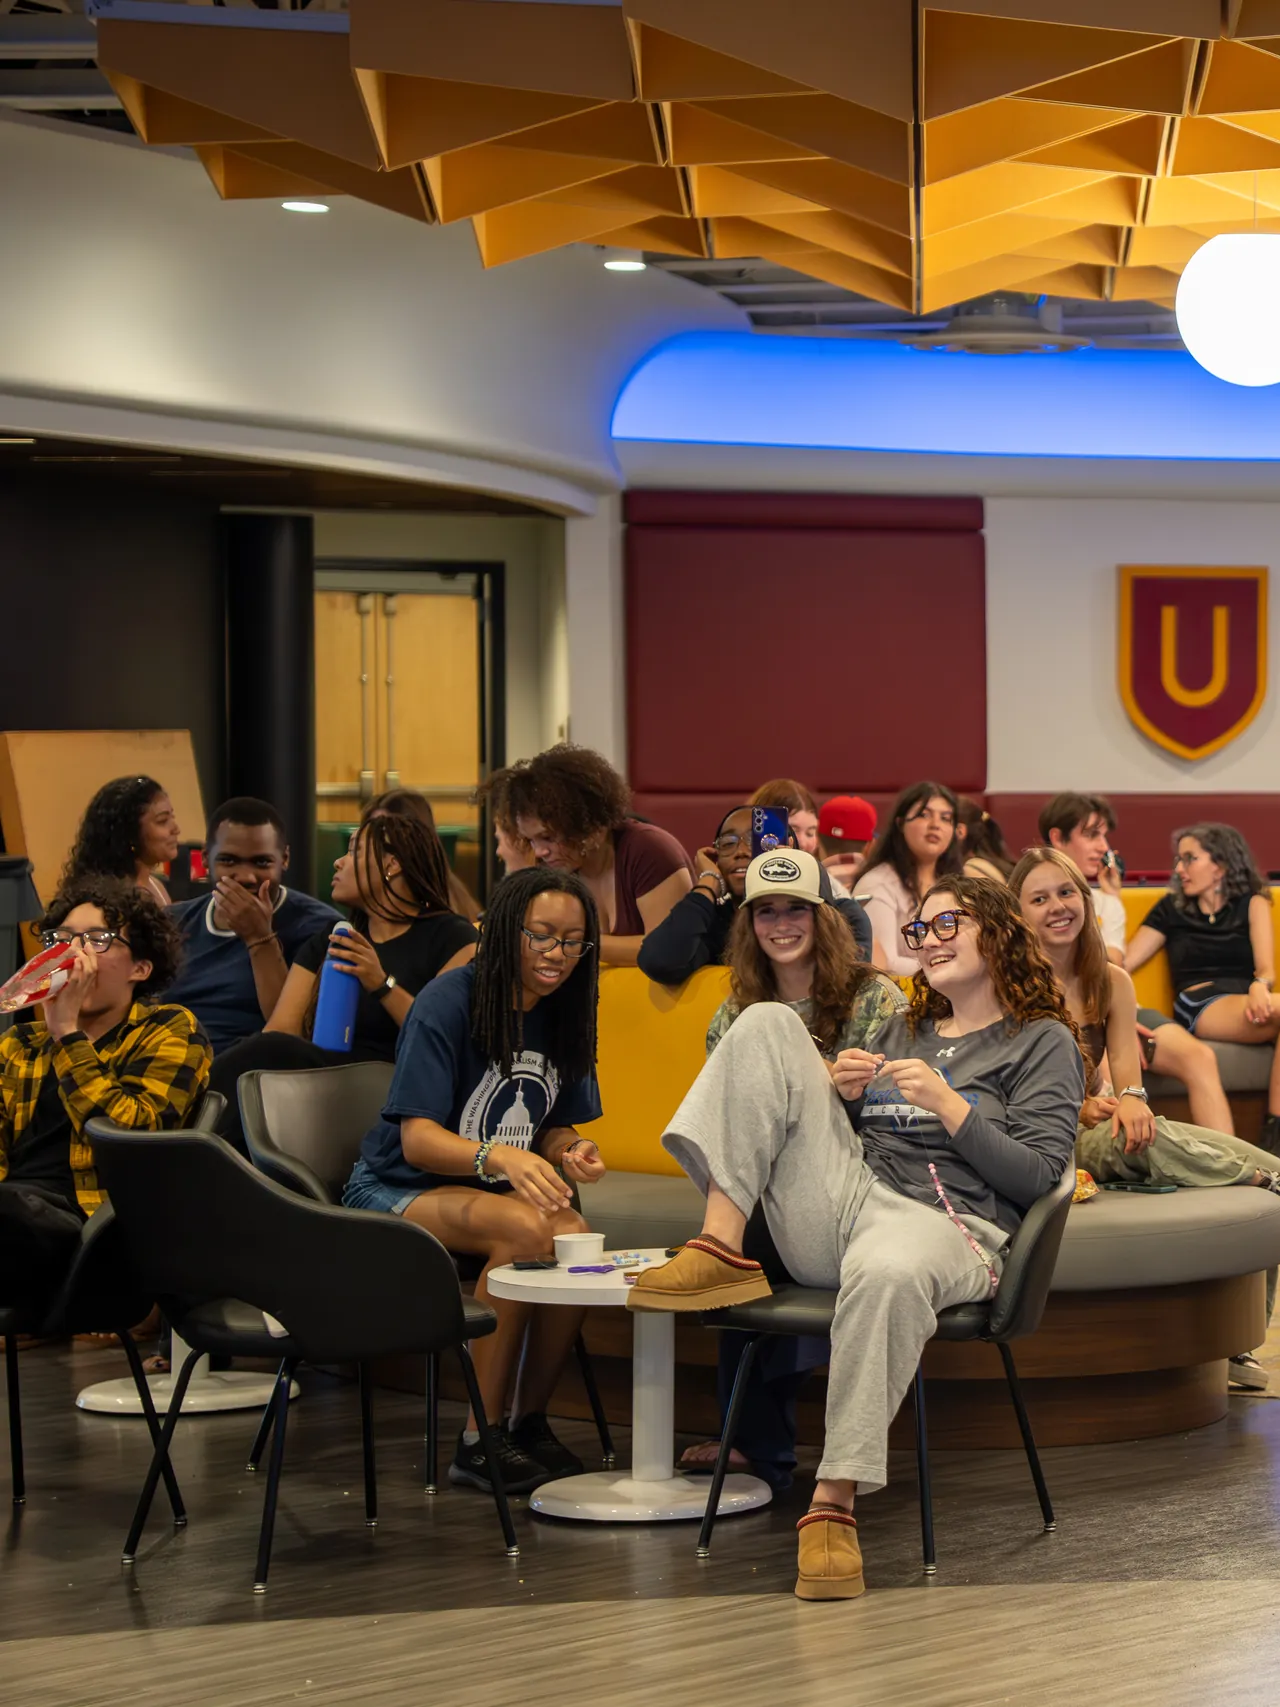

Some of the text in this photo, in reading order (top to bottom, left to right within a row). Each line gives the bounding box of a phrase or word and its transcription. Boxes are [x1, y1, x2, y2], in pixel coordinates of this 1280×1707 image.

[1161, 605, 1229, 708] U
[465, 1119, 474, 1134] THE
[470, 1070, 498, 1118] WASHINGTON
